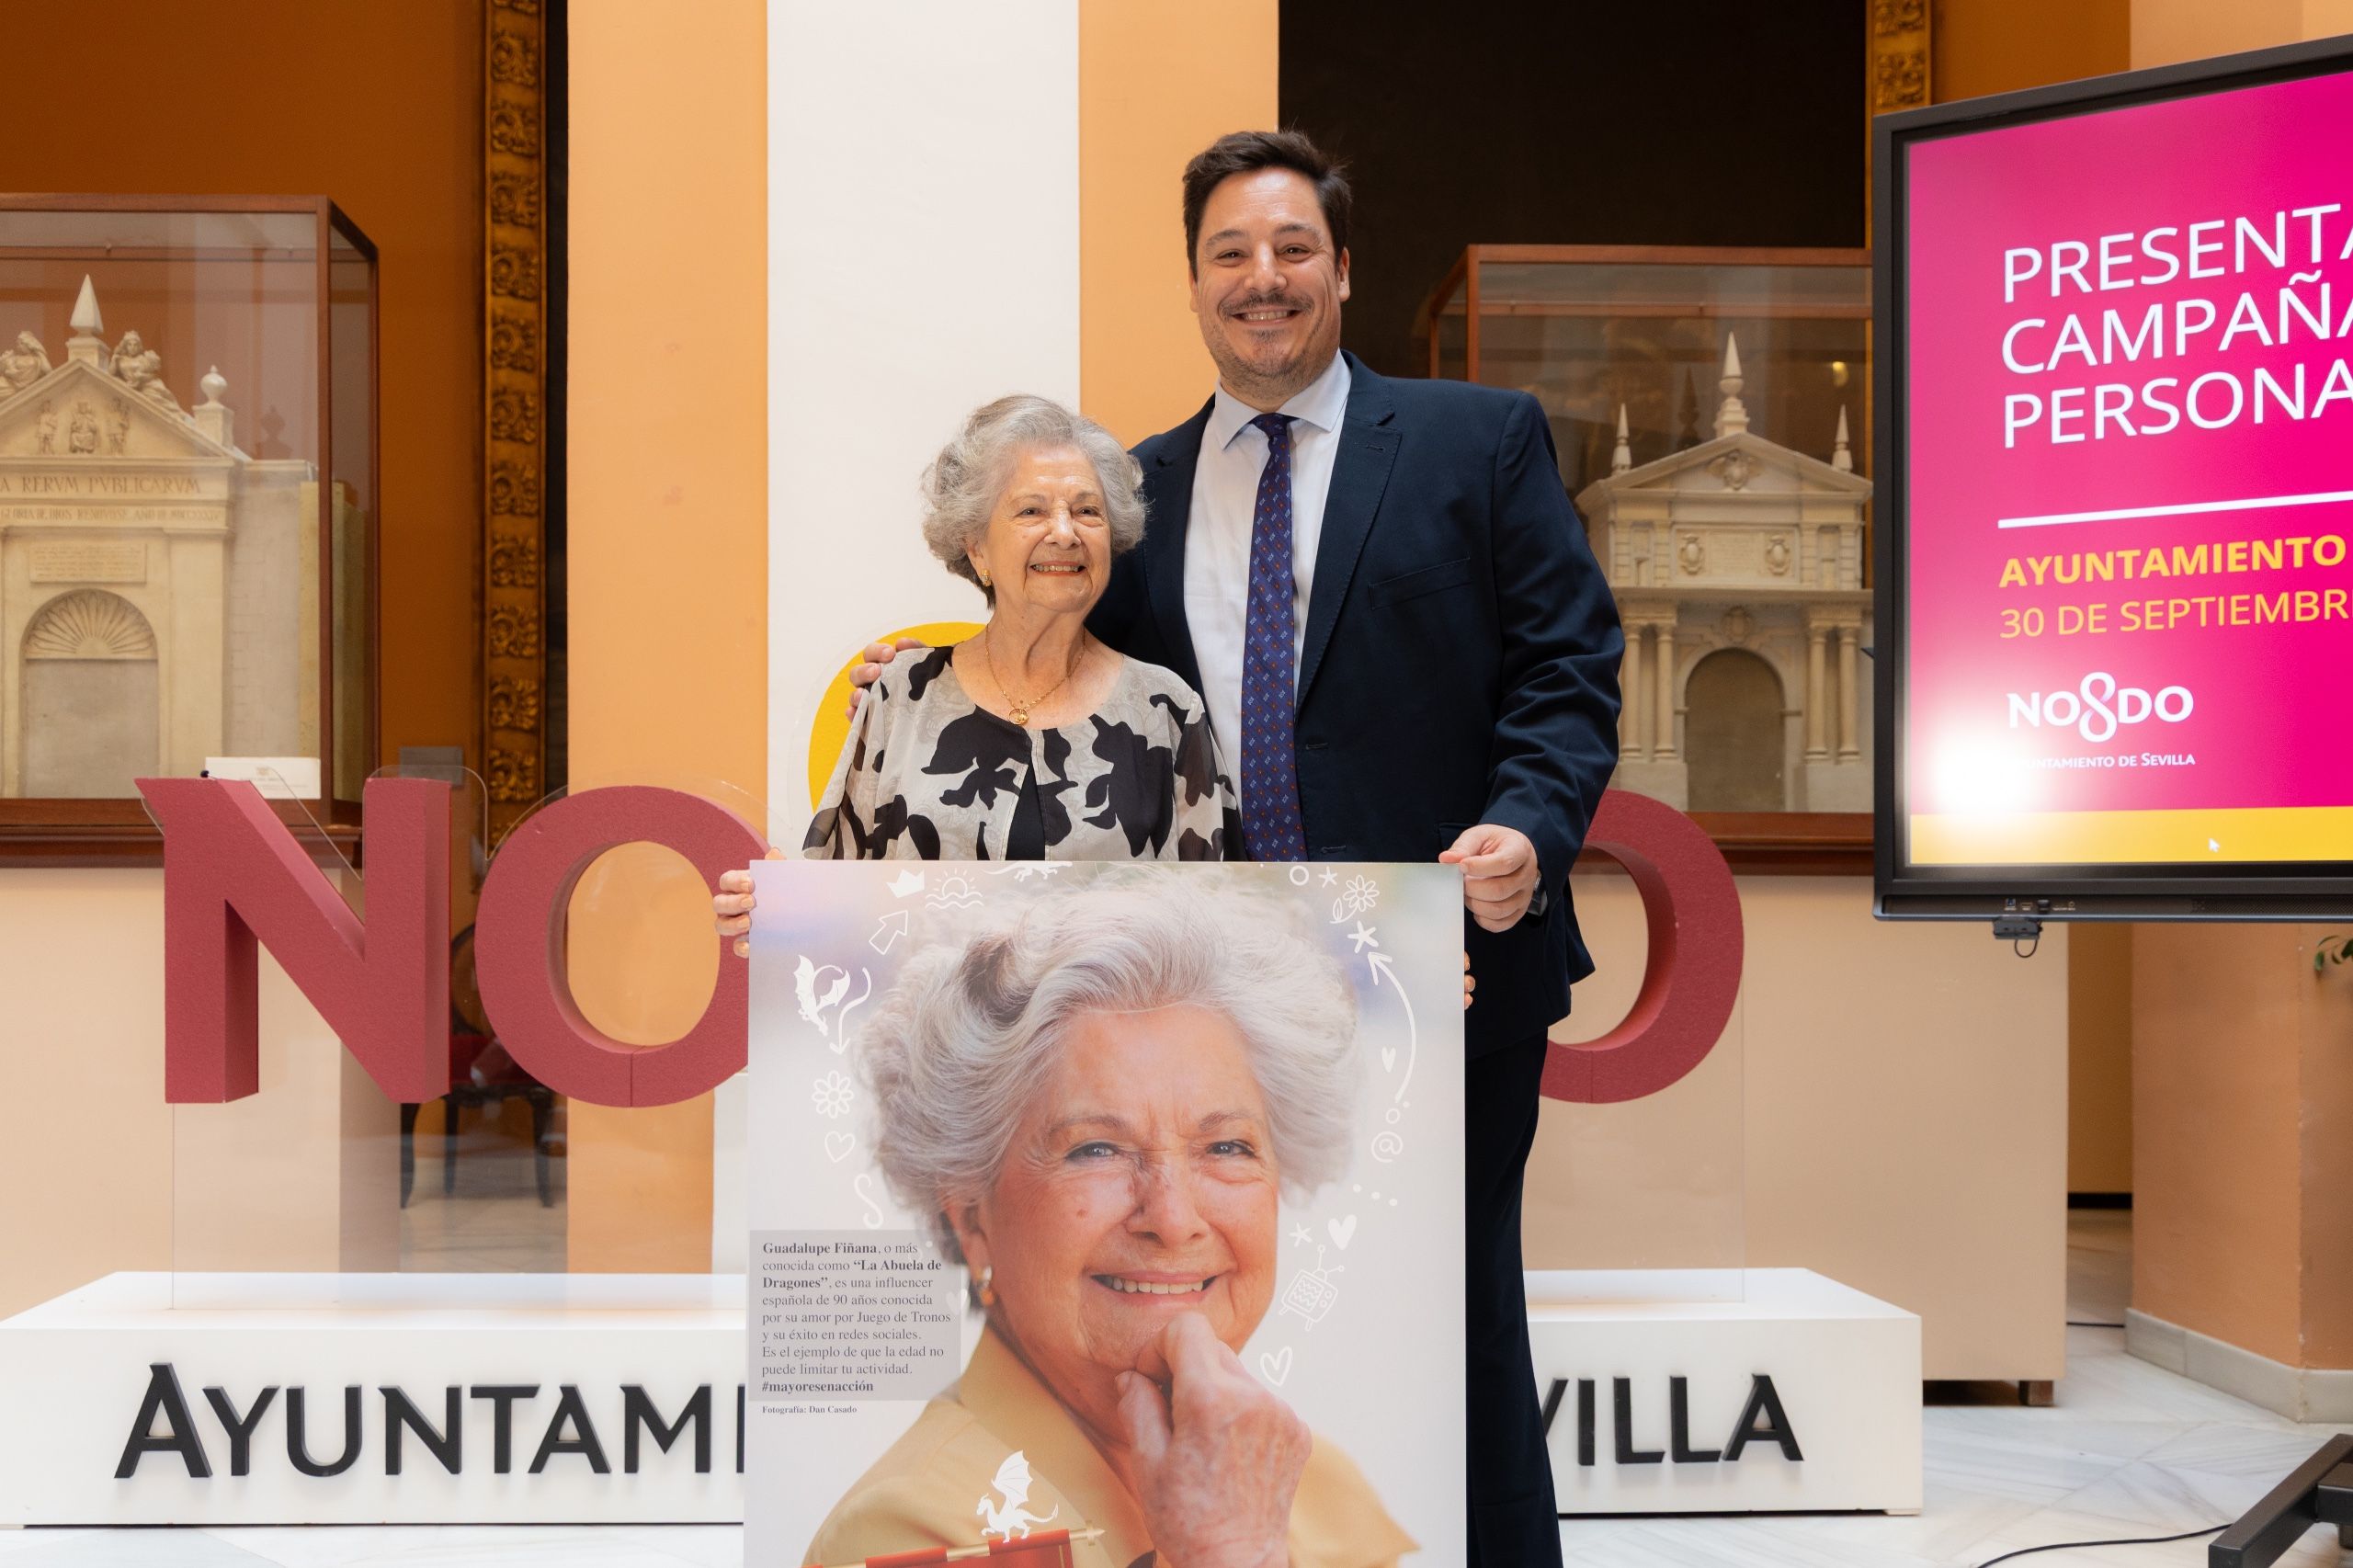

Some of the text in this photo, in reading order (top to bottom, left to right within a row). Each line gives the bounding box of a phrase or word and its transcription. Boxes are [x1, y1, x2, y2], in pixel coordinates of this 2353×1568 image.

[2005, 203, 2353, 303] PRESENT
[1998, 534, 2347, 587] AYUNTAMIENTO
[2000, 588, 2353, 638] 30 DE SEPTIEMBR
[835, 1242, 881, 1256] Fiñana,
[884, 1245, 892, 1254] o
[895, 1243, 918, 1254] más
[853, 1259, 877, 1270] “La
[881, 1259, 924, 1271] Abuela
[927, 1259, 942, 1270] de
[835, 1279, 847, 1289] es
[850, 1279, 871, 1289] una
[816, 1294, 829, 1305] de
[833, 1294, 847, 1305] 90
[851, 1294, 877, 1305] años
[762, 1311, 951, 1325] por su amor por Juego de Tronos
[762, 1332, 768, 1343] y
[773, 1331, 786, 1340] su
[789, 1329, 818, 1340] éxito
[821, 1331, 835, 1340] en
[838, 1329, 869, 1340] redes
[762, 1346, 944, 1360] Es el ejemplo de que la edad no
[762, 1364, 796, 1377] puede
[800, 1363, 838, 1375] limitar
[842, 1364, 853, 1374] tu
